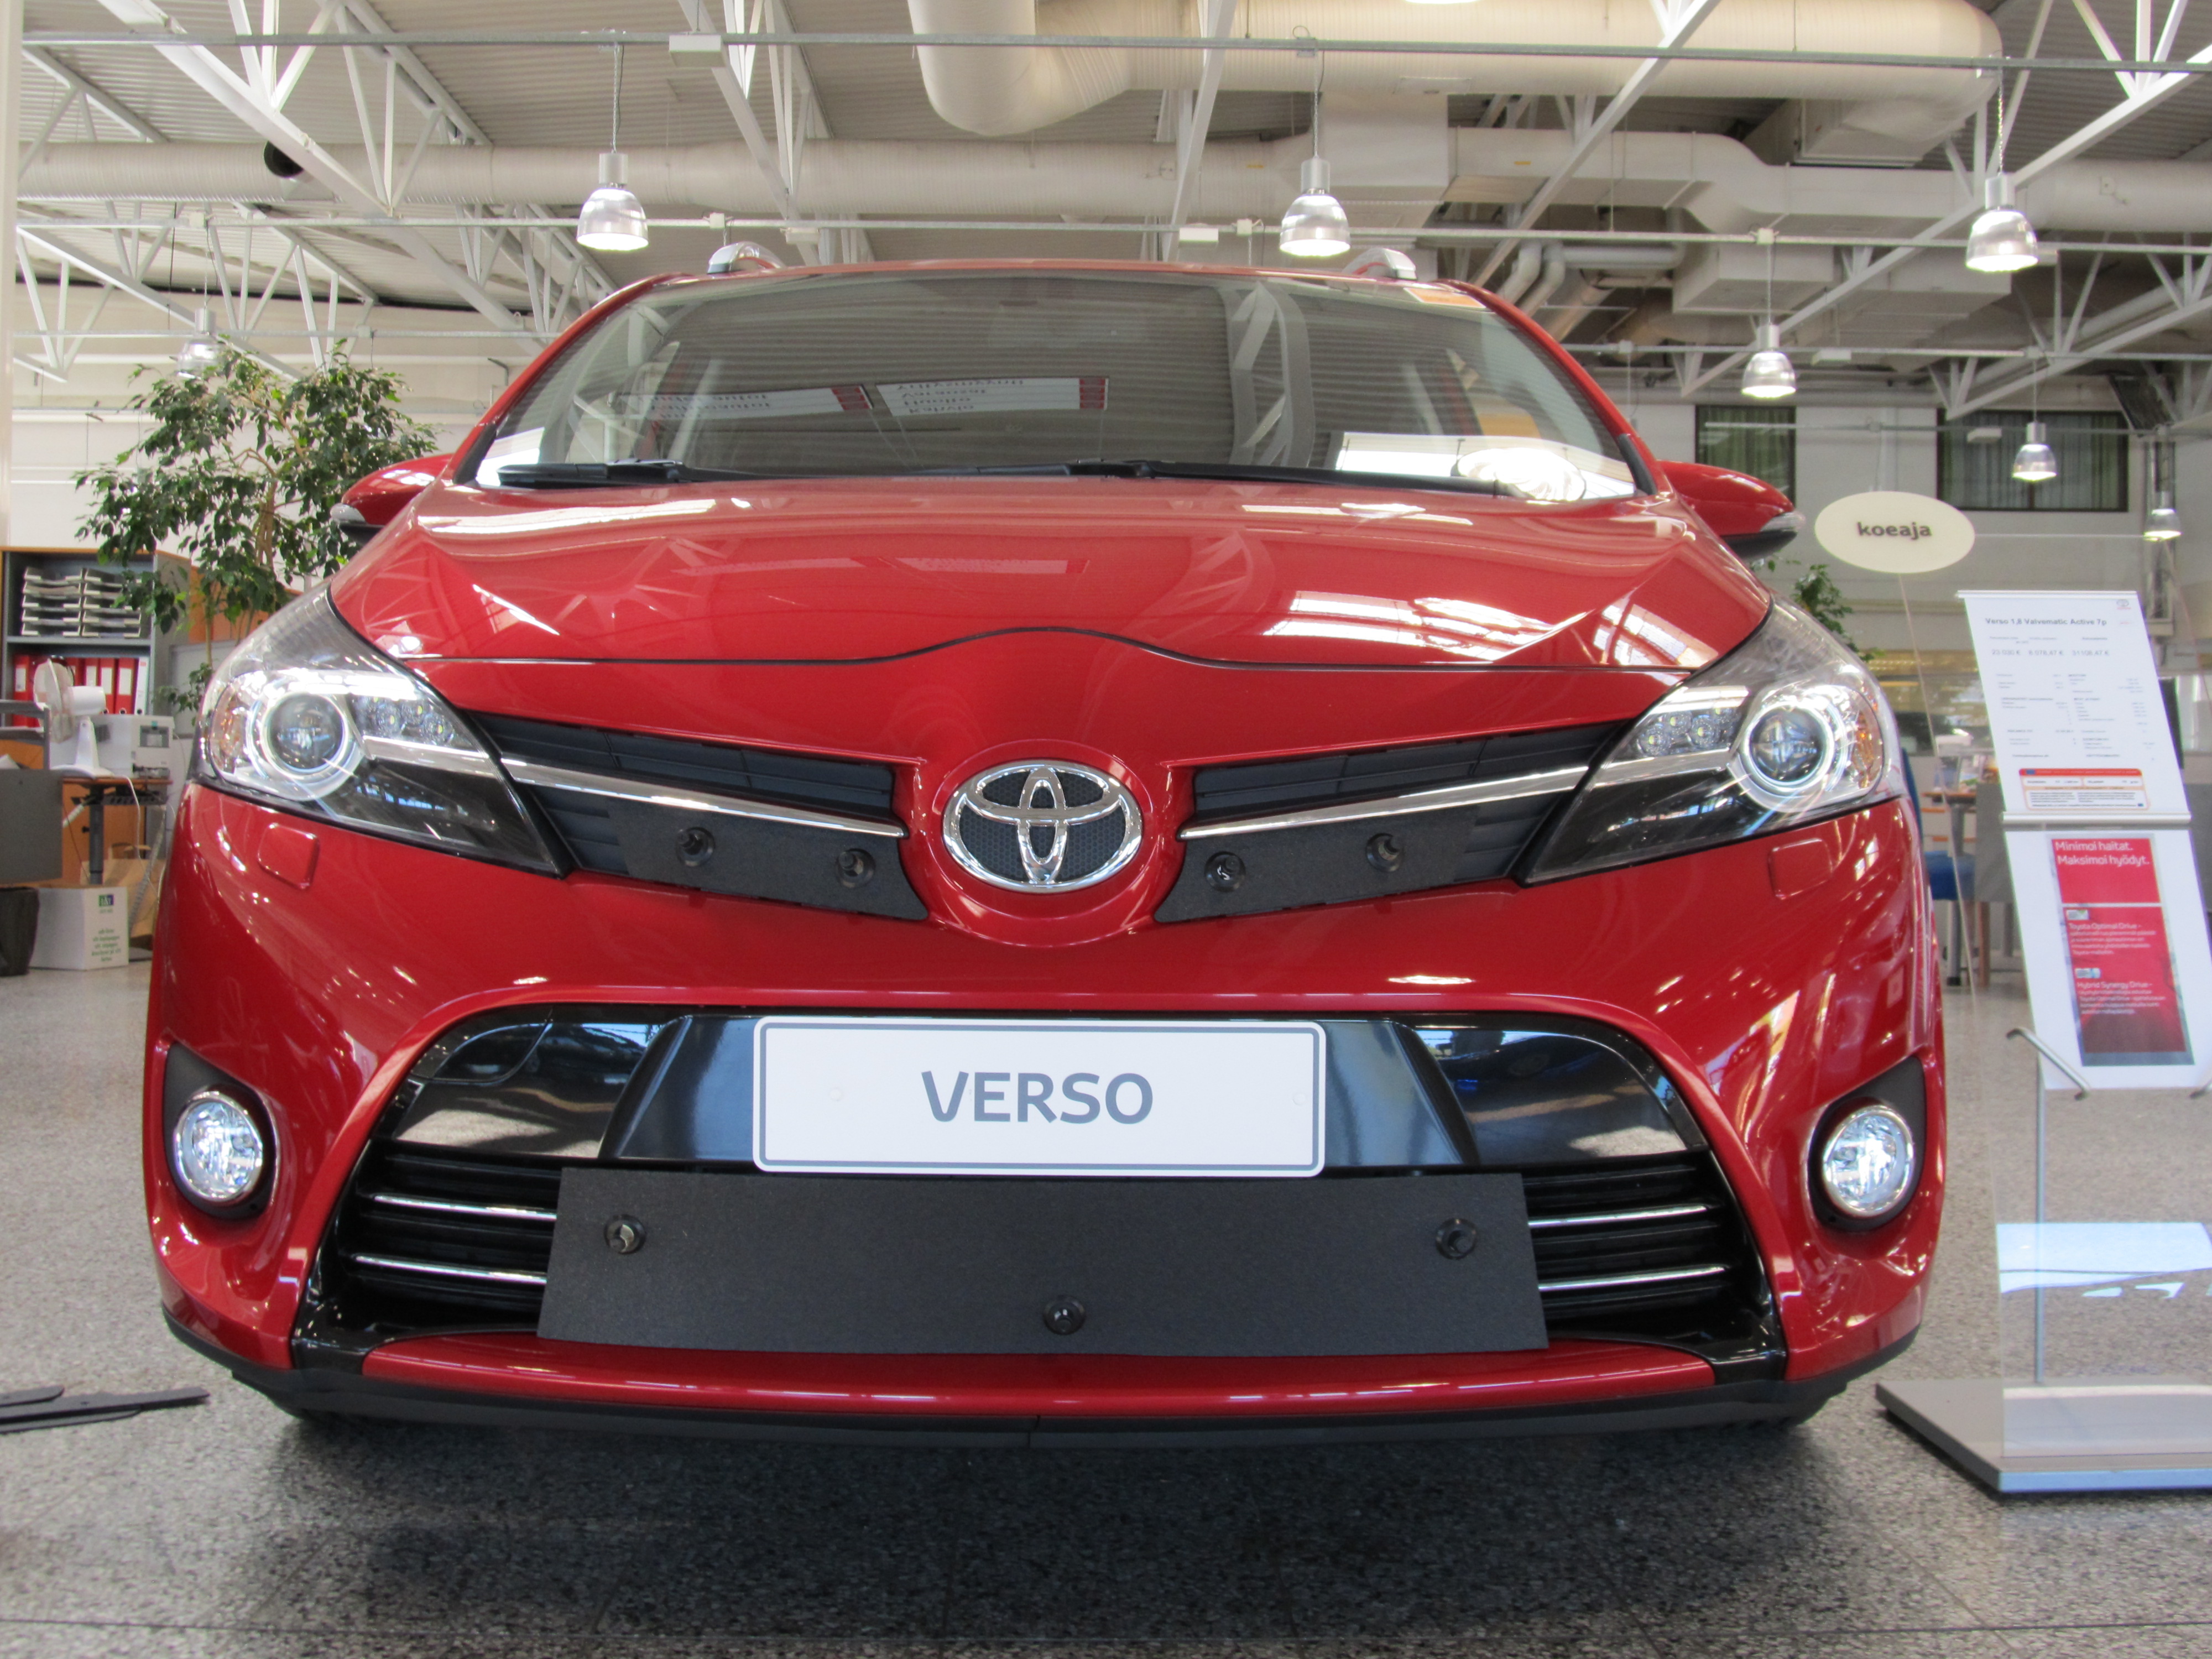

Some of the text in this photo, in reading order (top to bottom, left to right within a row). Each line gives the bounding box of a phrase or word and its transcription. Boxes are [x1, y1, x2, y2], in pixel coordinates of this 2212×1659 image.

[1857, 521, 1932, 540] koeaja
[2056, 841, 2133, 851] Minimoi haitat.
[2057, 855, 2150, 867] Maksimoi hyödyt.
[921, 1071, 1153, 1124] VERSO
